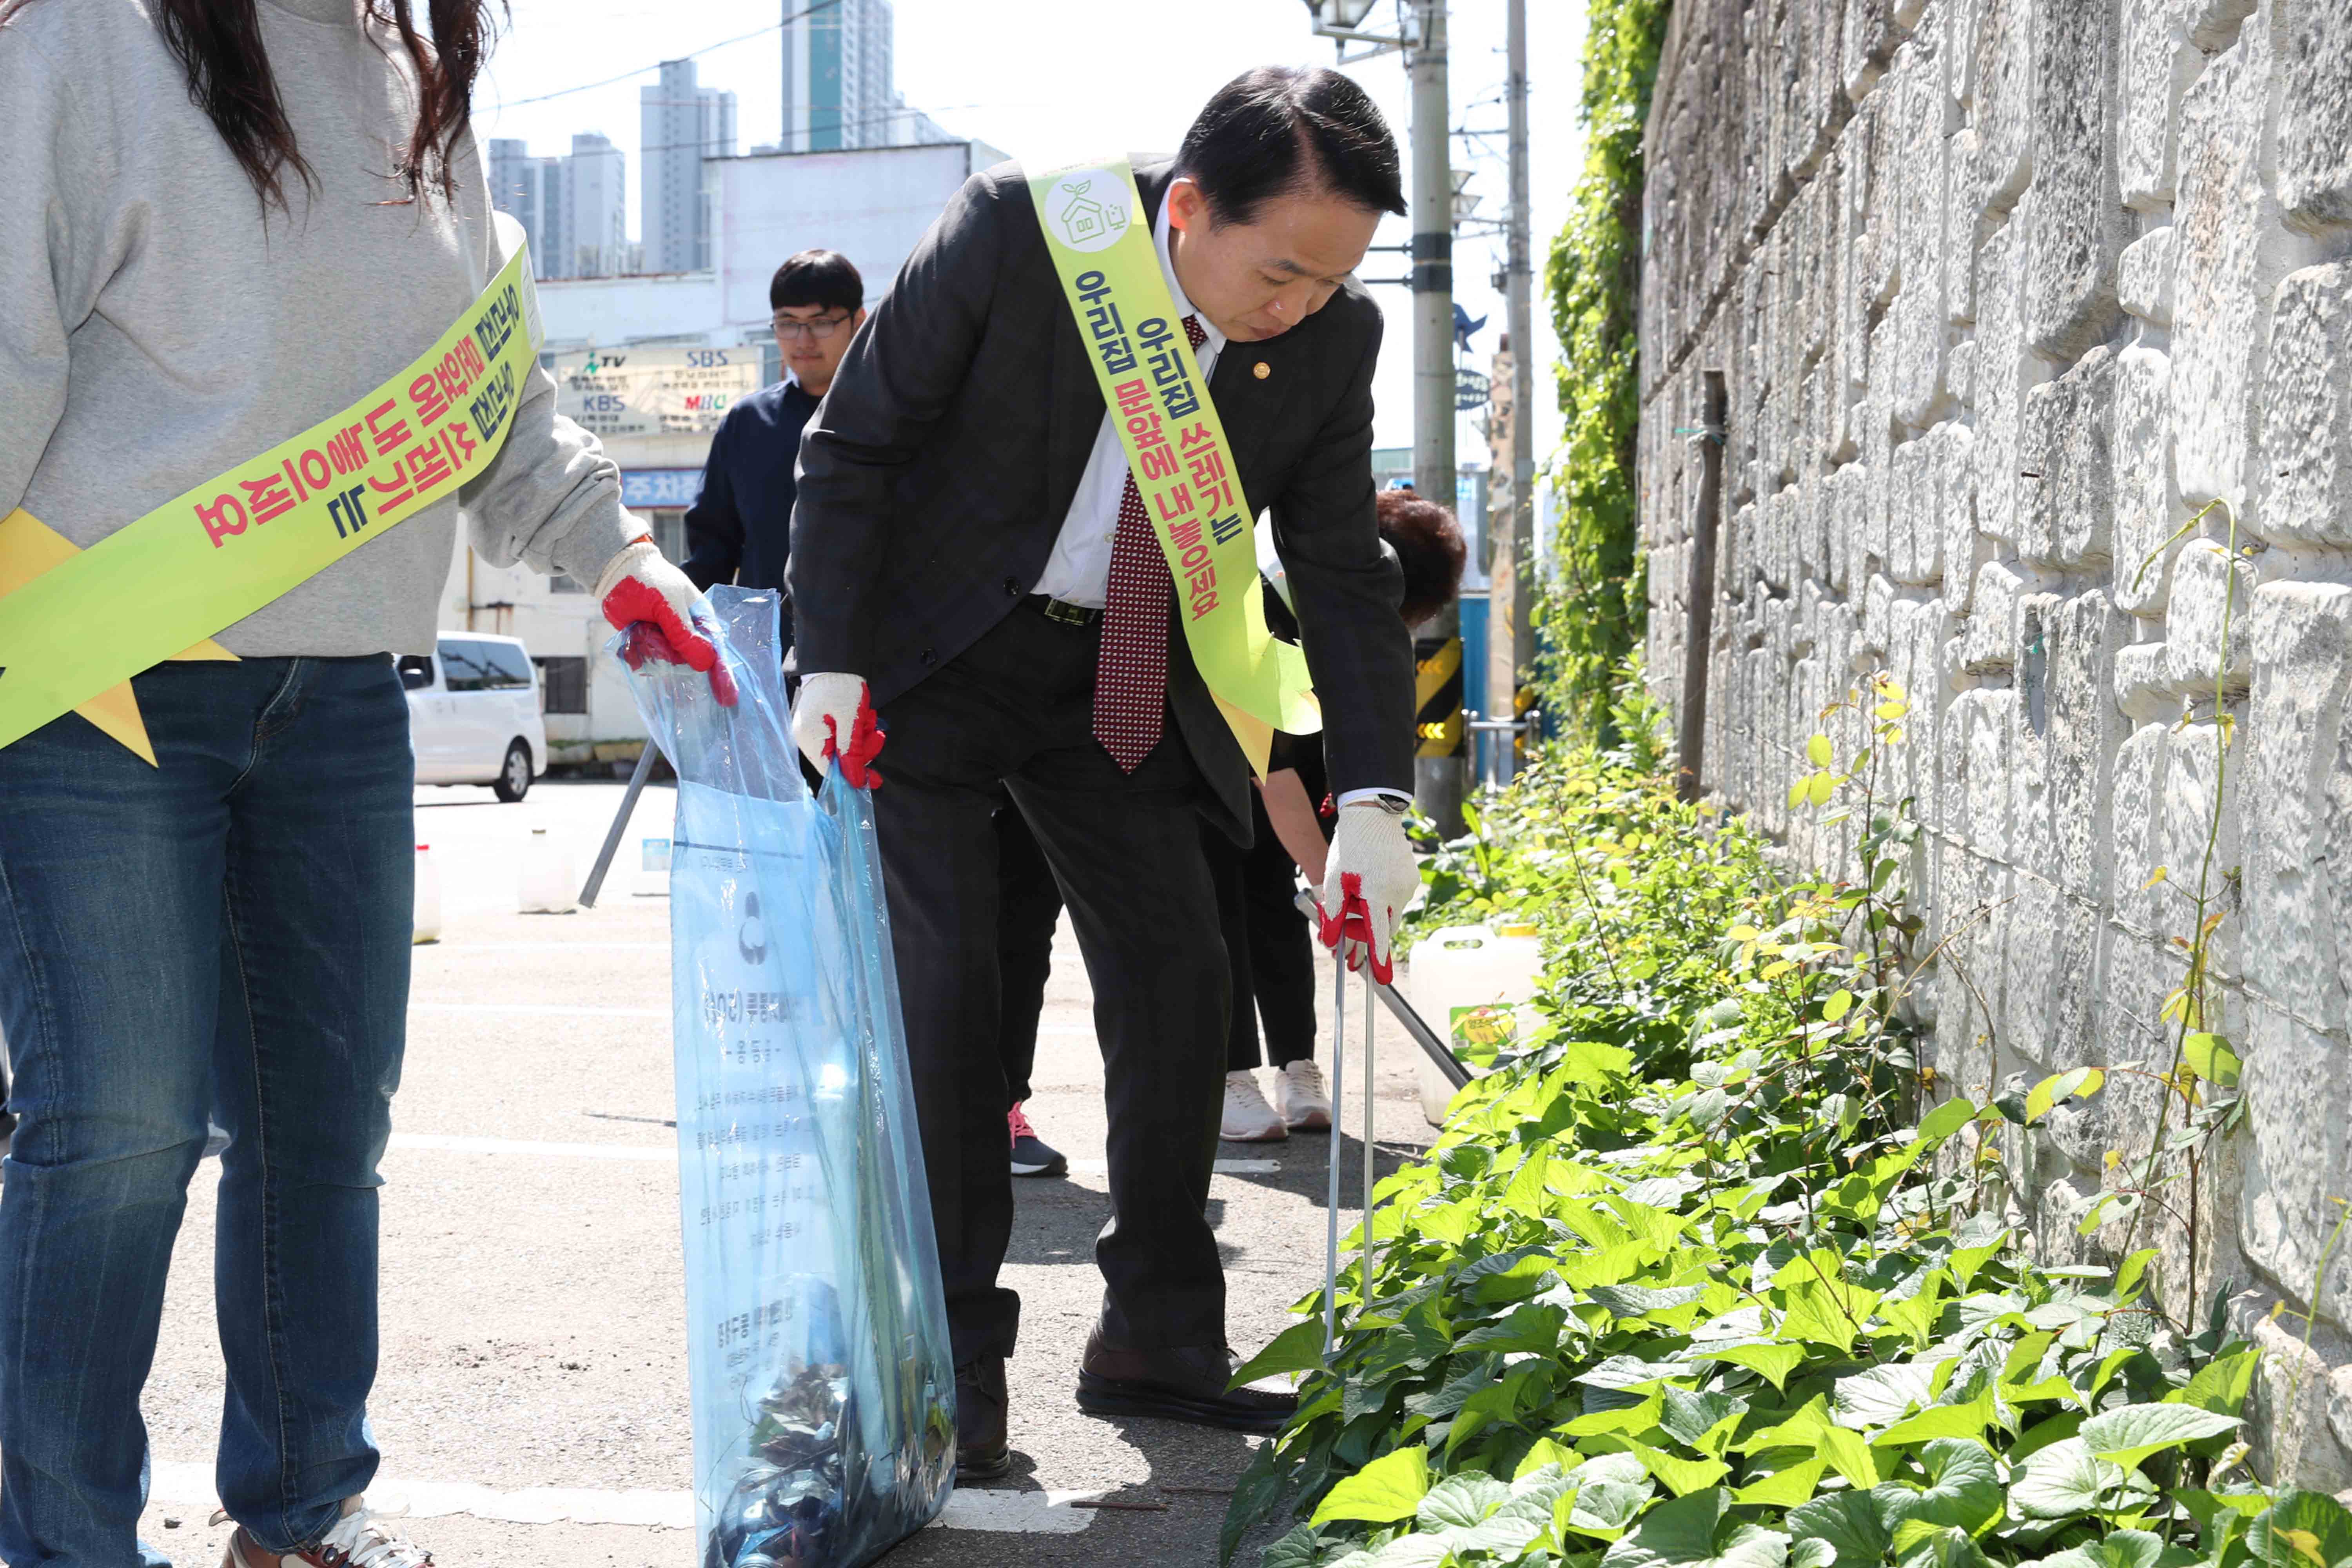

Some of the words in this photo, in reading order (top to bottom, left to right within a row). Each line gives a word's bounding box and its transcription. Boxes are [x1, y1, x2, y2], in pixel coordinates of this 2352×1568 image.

[475, 283, 519, 362] 우리집
[687, 351, 728, 367] SBS
[408, 335, 485, 426] 문앞에
[470, 360, 514, 443] 우리집
[584, 395, 626, 412] KBS
[685, 395, 726, 410] MBC
[1076, 270, 1137, 375] 우리집
[1114, 378, 1180, 481] 문앞에
[1136, 318, 1200, 420] 우리집
[1181, 422, 1242, 544] 쓰레기는
[327, 421, 478, 538] 쓰레기는
